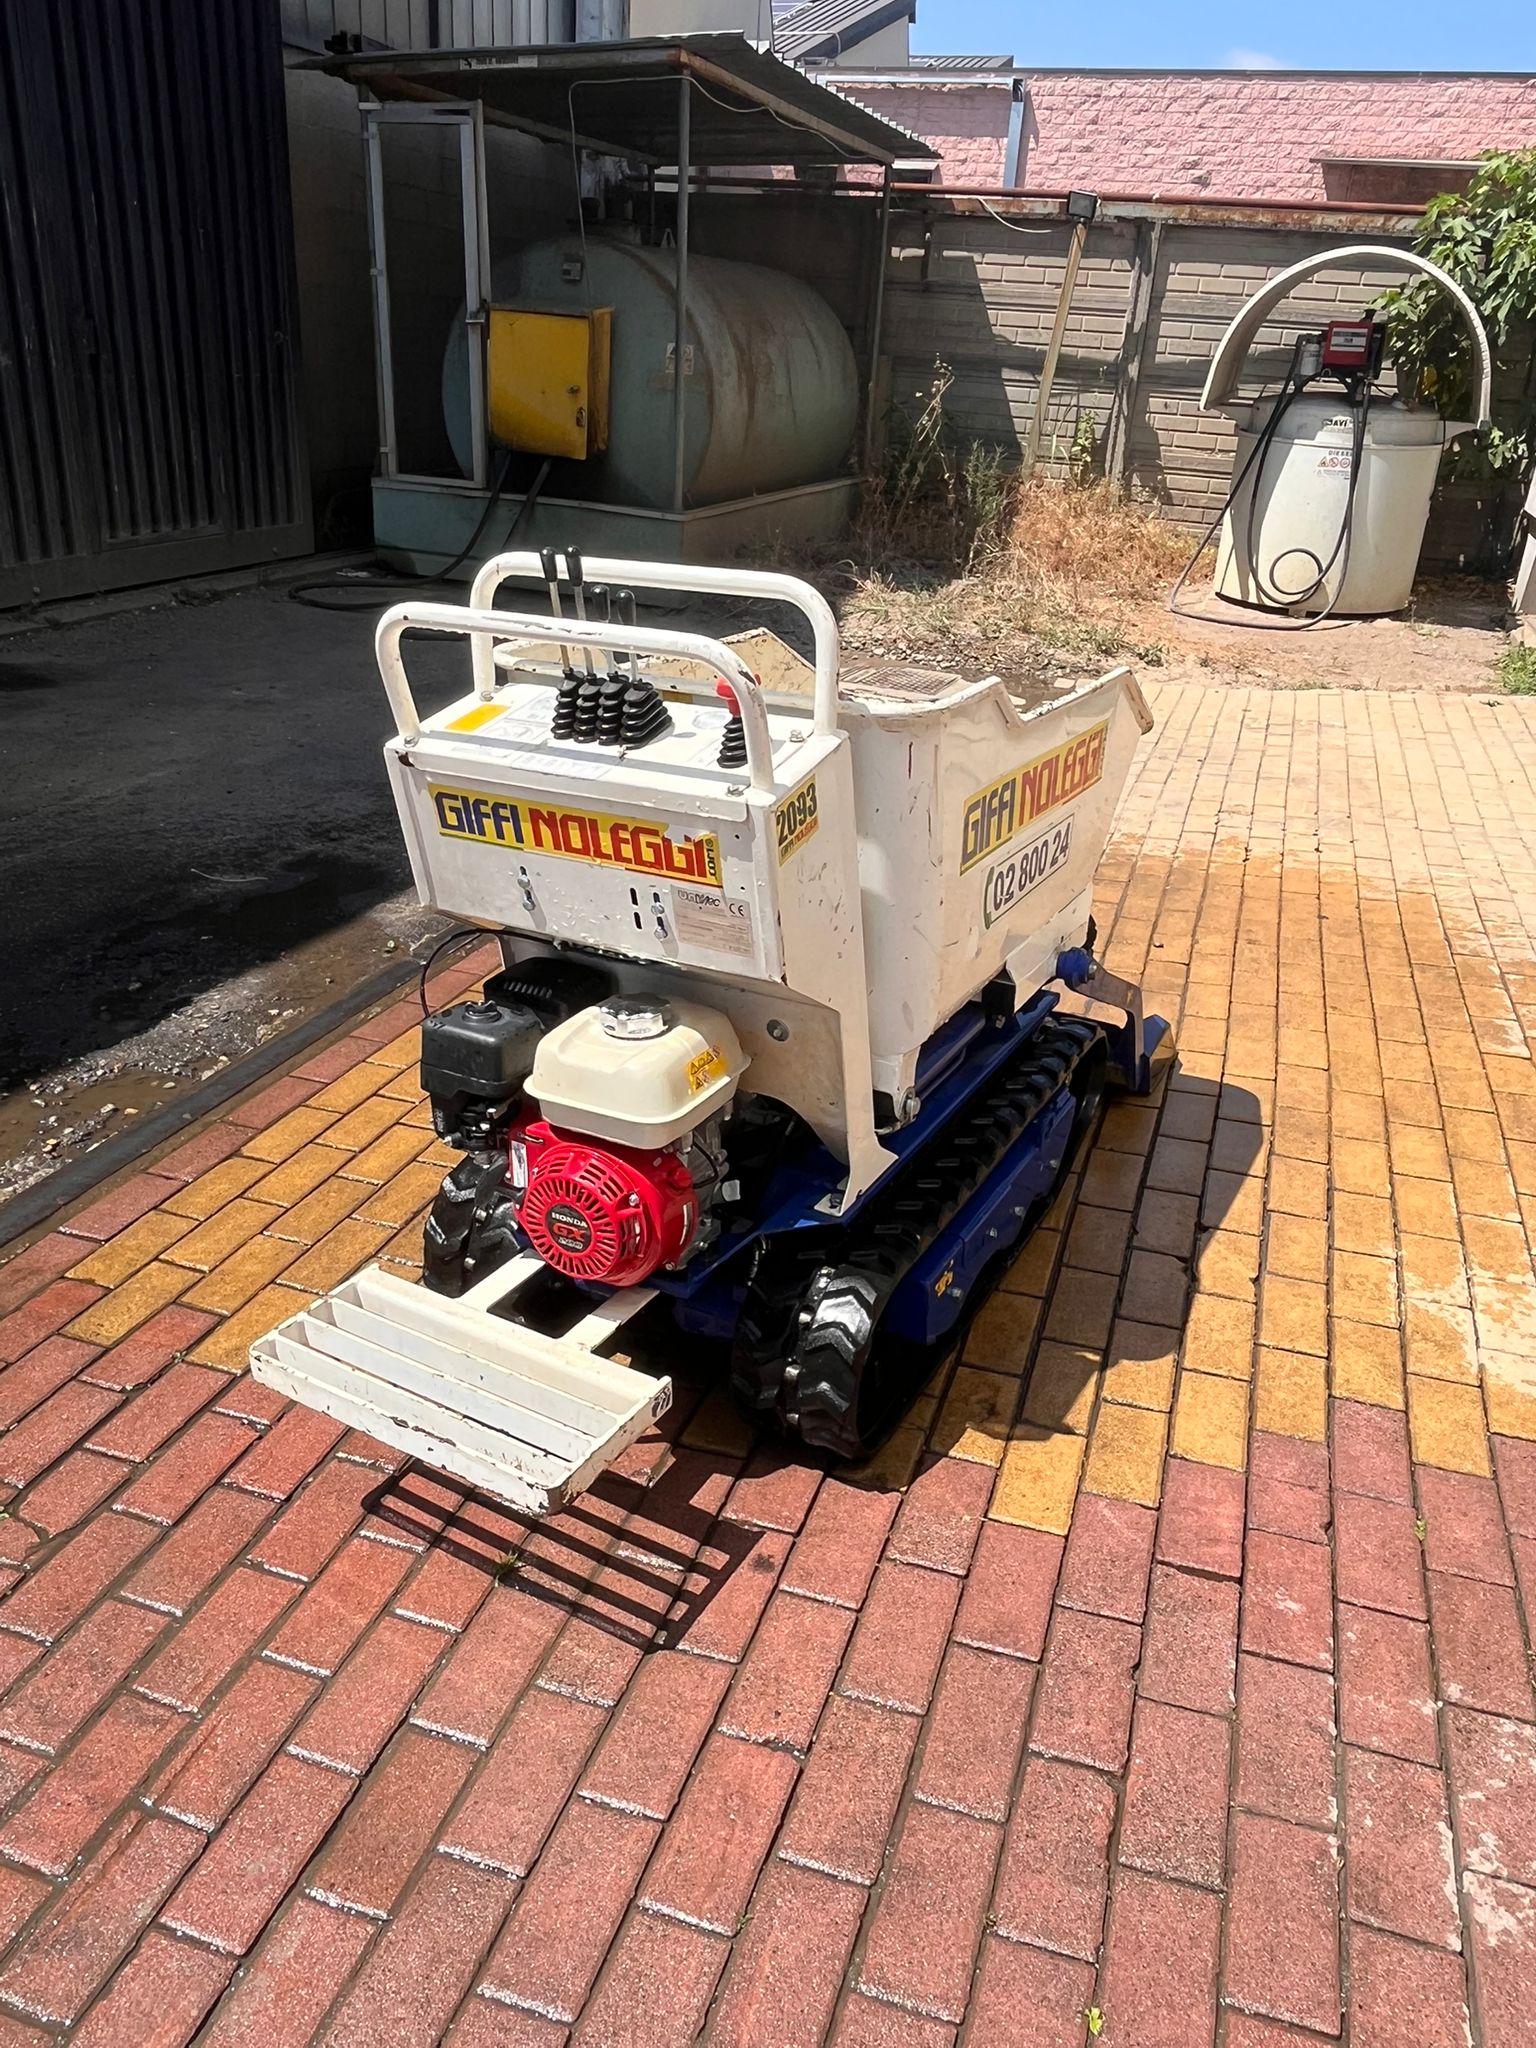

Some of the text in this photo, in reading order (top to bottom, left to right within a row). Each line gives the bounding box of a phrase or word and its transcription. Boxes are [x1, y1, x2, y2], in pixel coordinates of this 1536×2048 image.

[436, 791, 708, 878] GIFFI NOLEGGI
[776, 782, 818, 847] 2093
[962, 777, 1017, 865] GIFFI
[1018, 726, 1105, 827] NOLEGGI
[993, 822, 1072, 911] 02 800 24
[551, 1212, 588, 1228] HONDA
